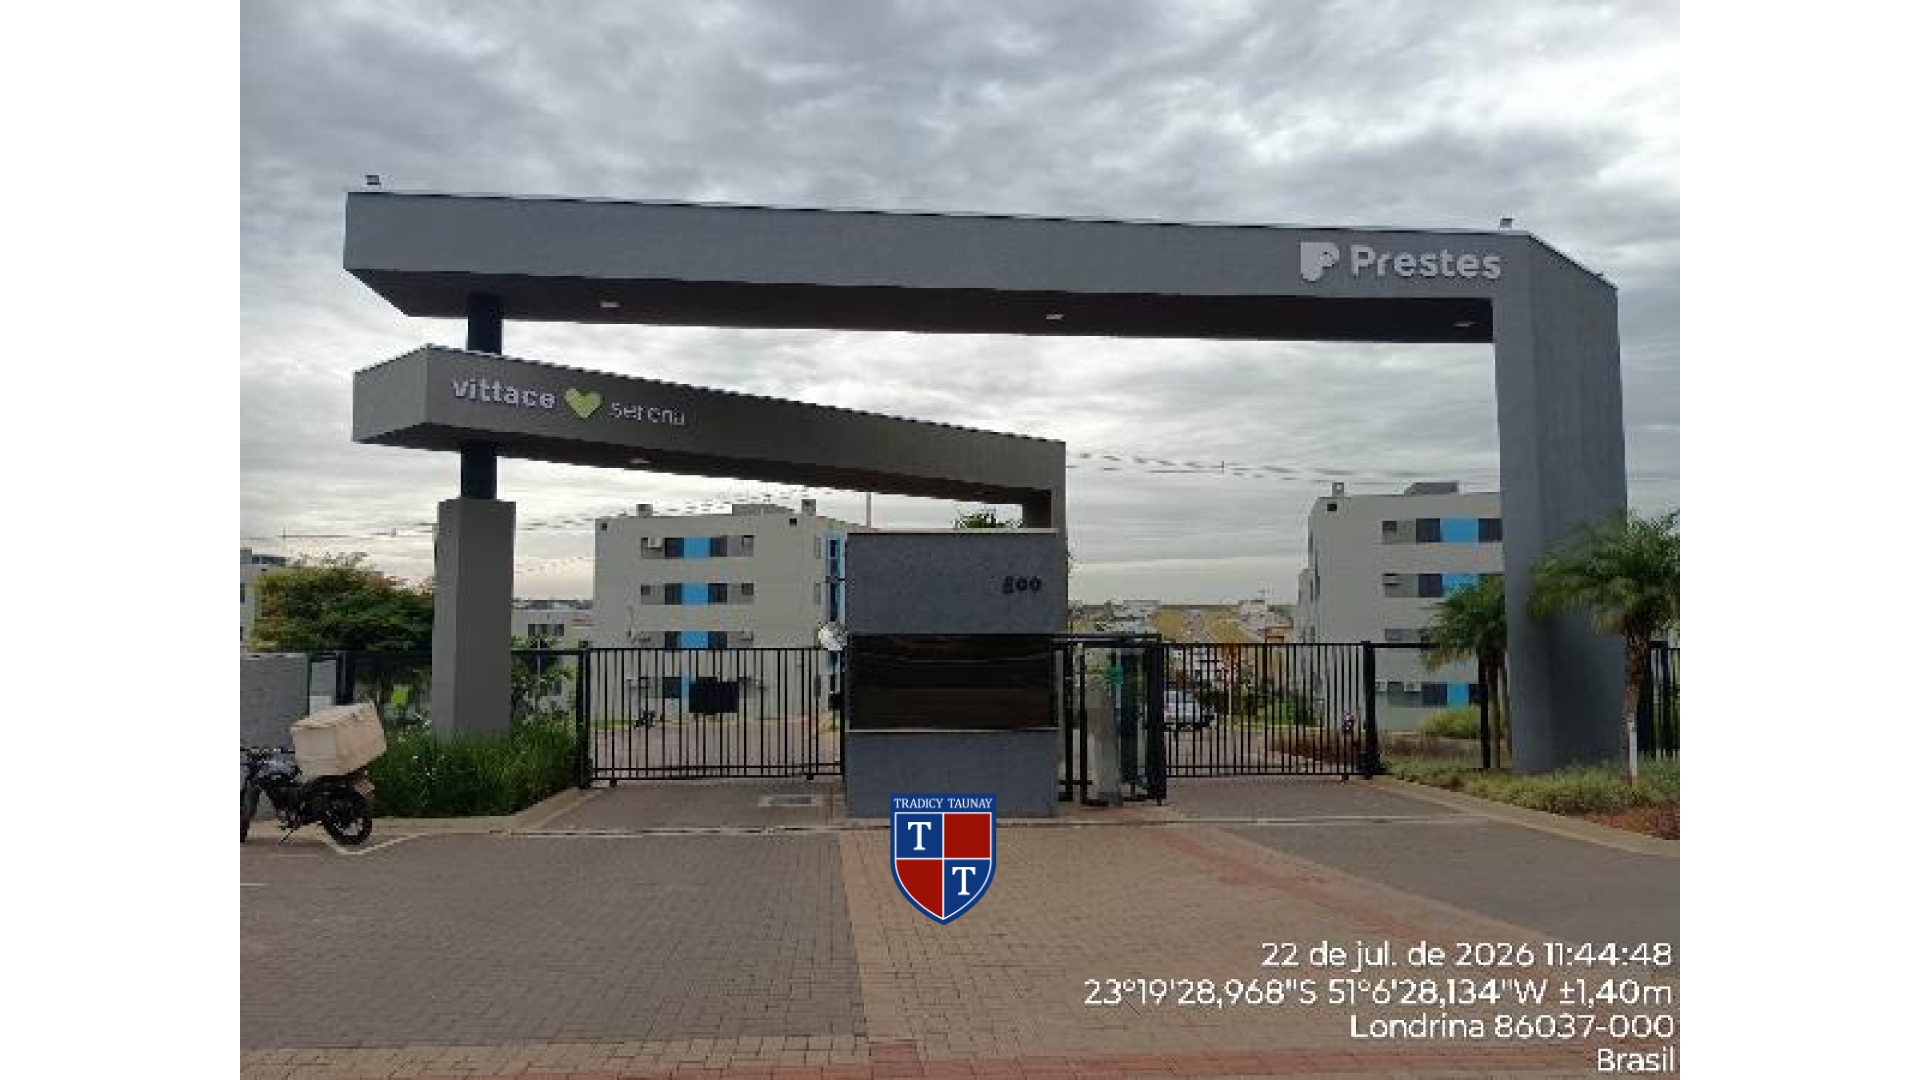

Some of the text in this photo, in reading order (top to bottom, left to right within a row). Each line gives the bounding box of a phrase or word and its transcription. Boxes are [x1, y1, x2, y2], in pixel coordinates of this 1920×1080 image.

[1351, 245, 1501, 278] Prestes
[453, 378, 686, 426] vittace serena
